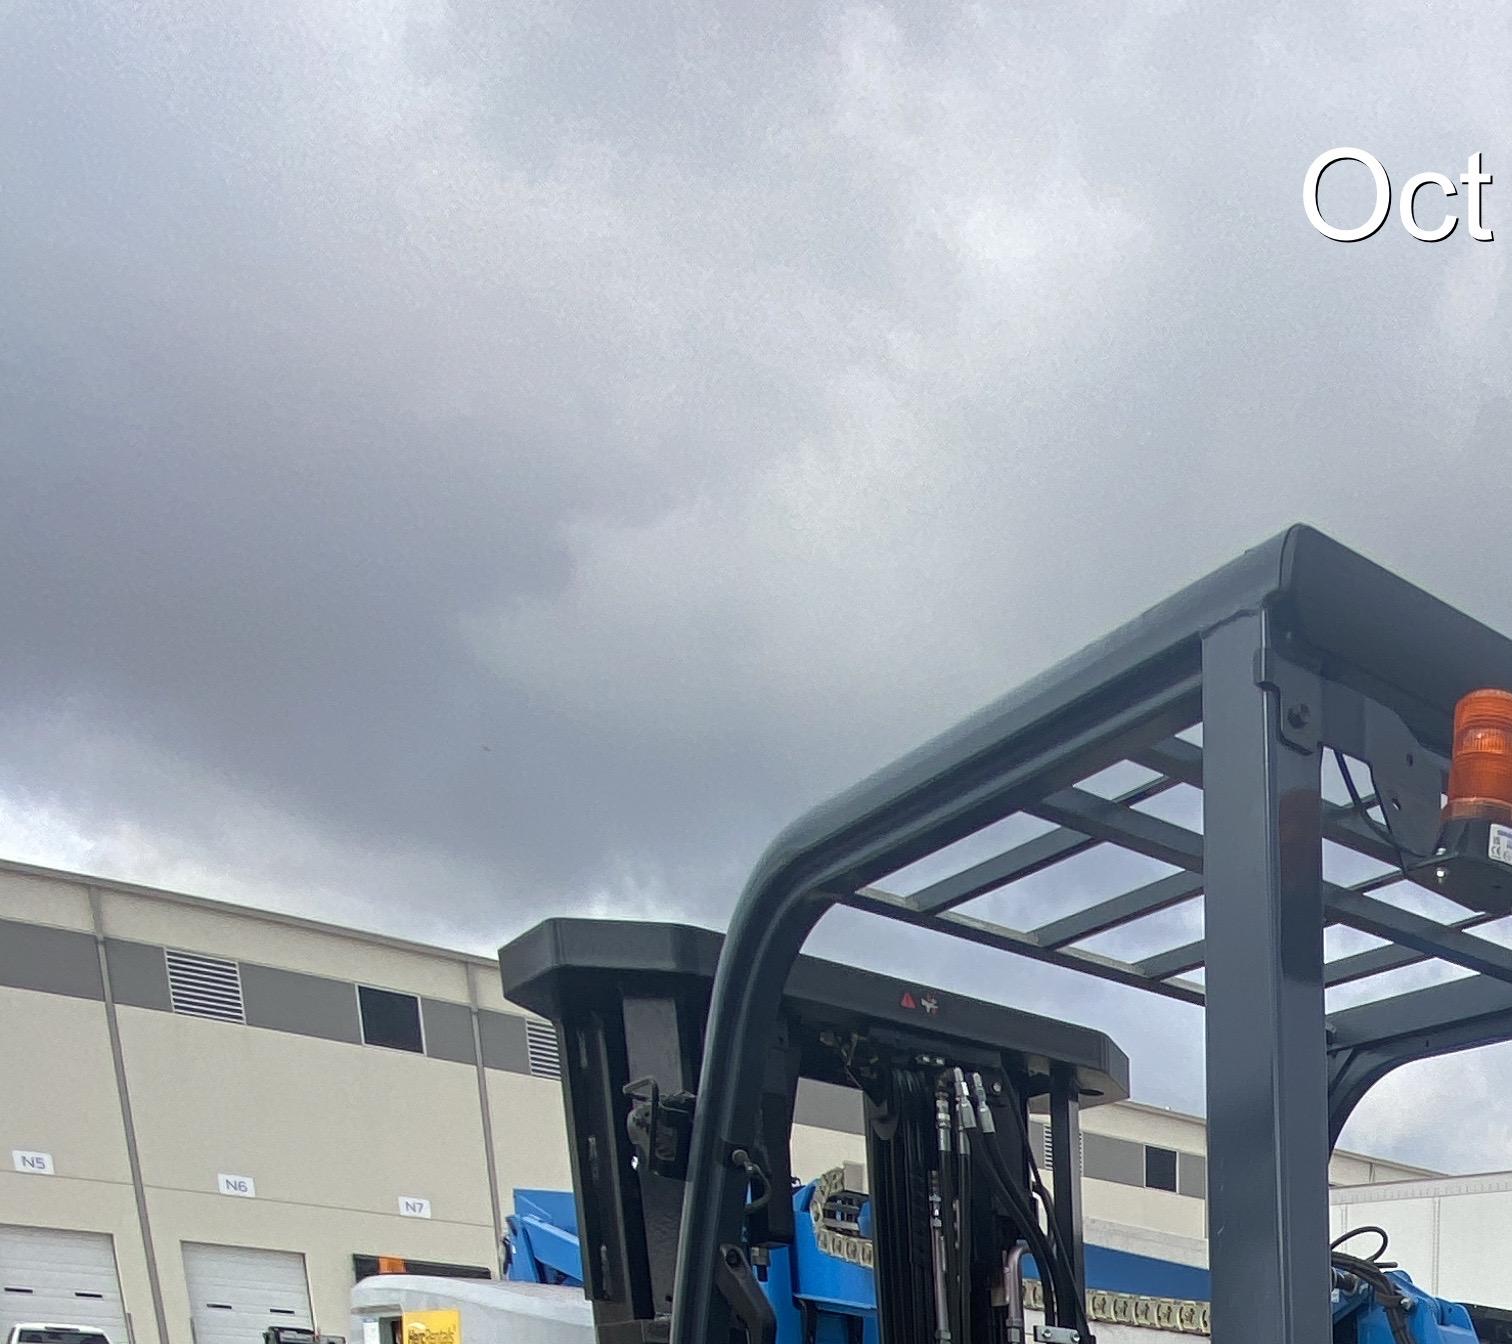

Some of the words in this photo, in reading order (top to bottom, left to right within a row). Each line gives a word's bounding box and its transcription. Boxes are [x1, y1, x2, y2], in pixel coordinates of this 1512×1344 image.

[20, 1155, 46, 1170] N5
[225, 1178, 248, 1193] N6
[405, 1200, 424, 1213] N7
